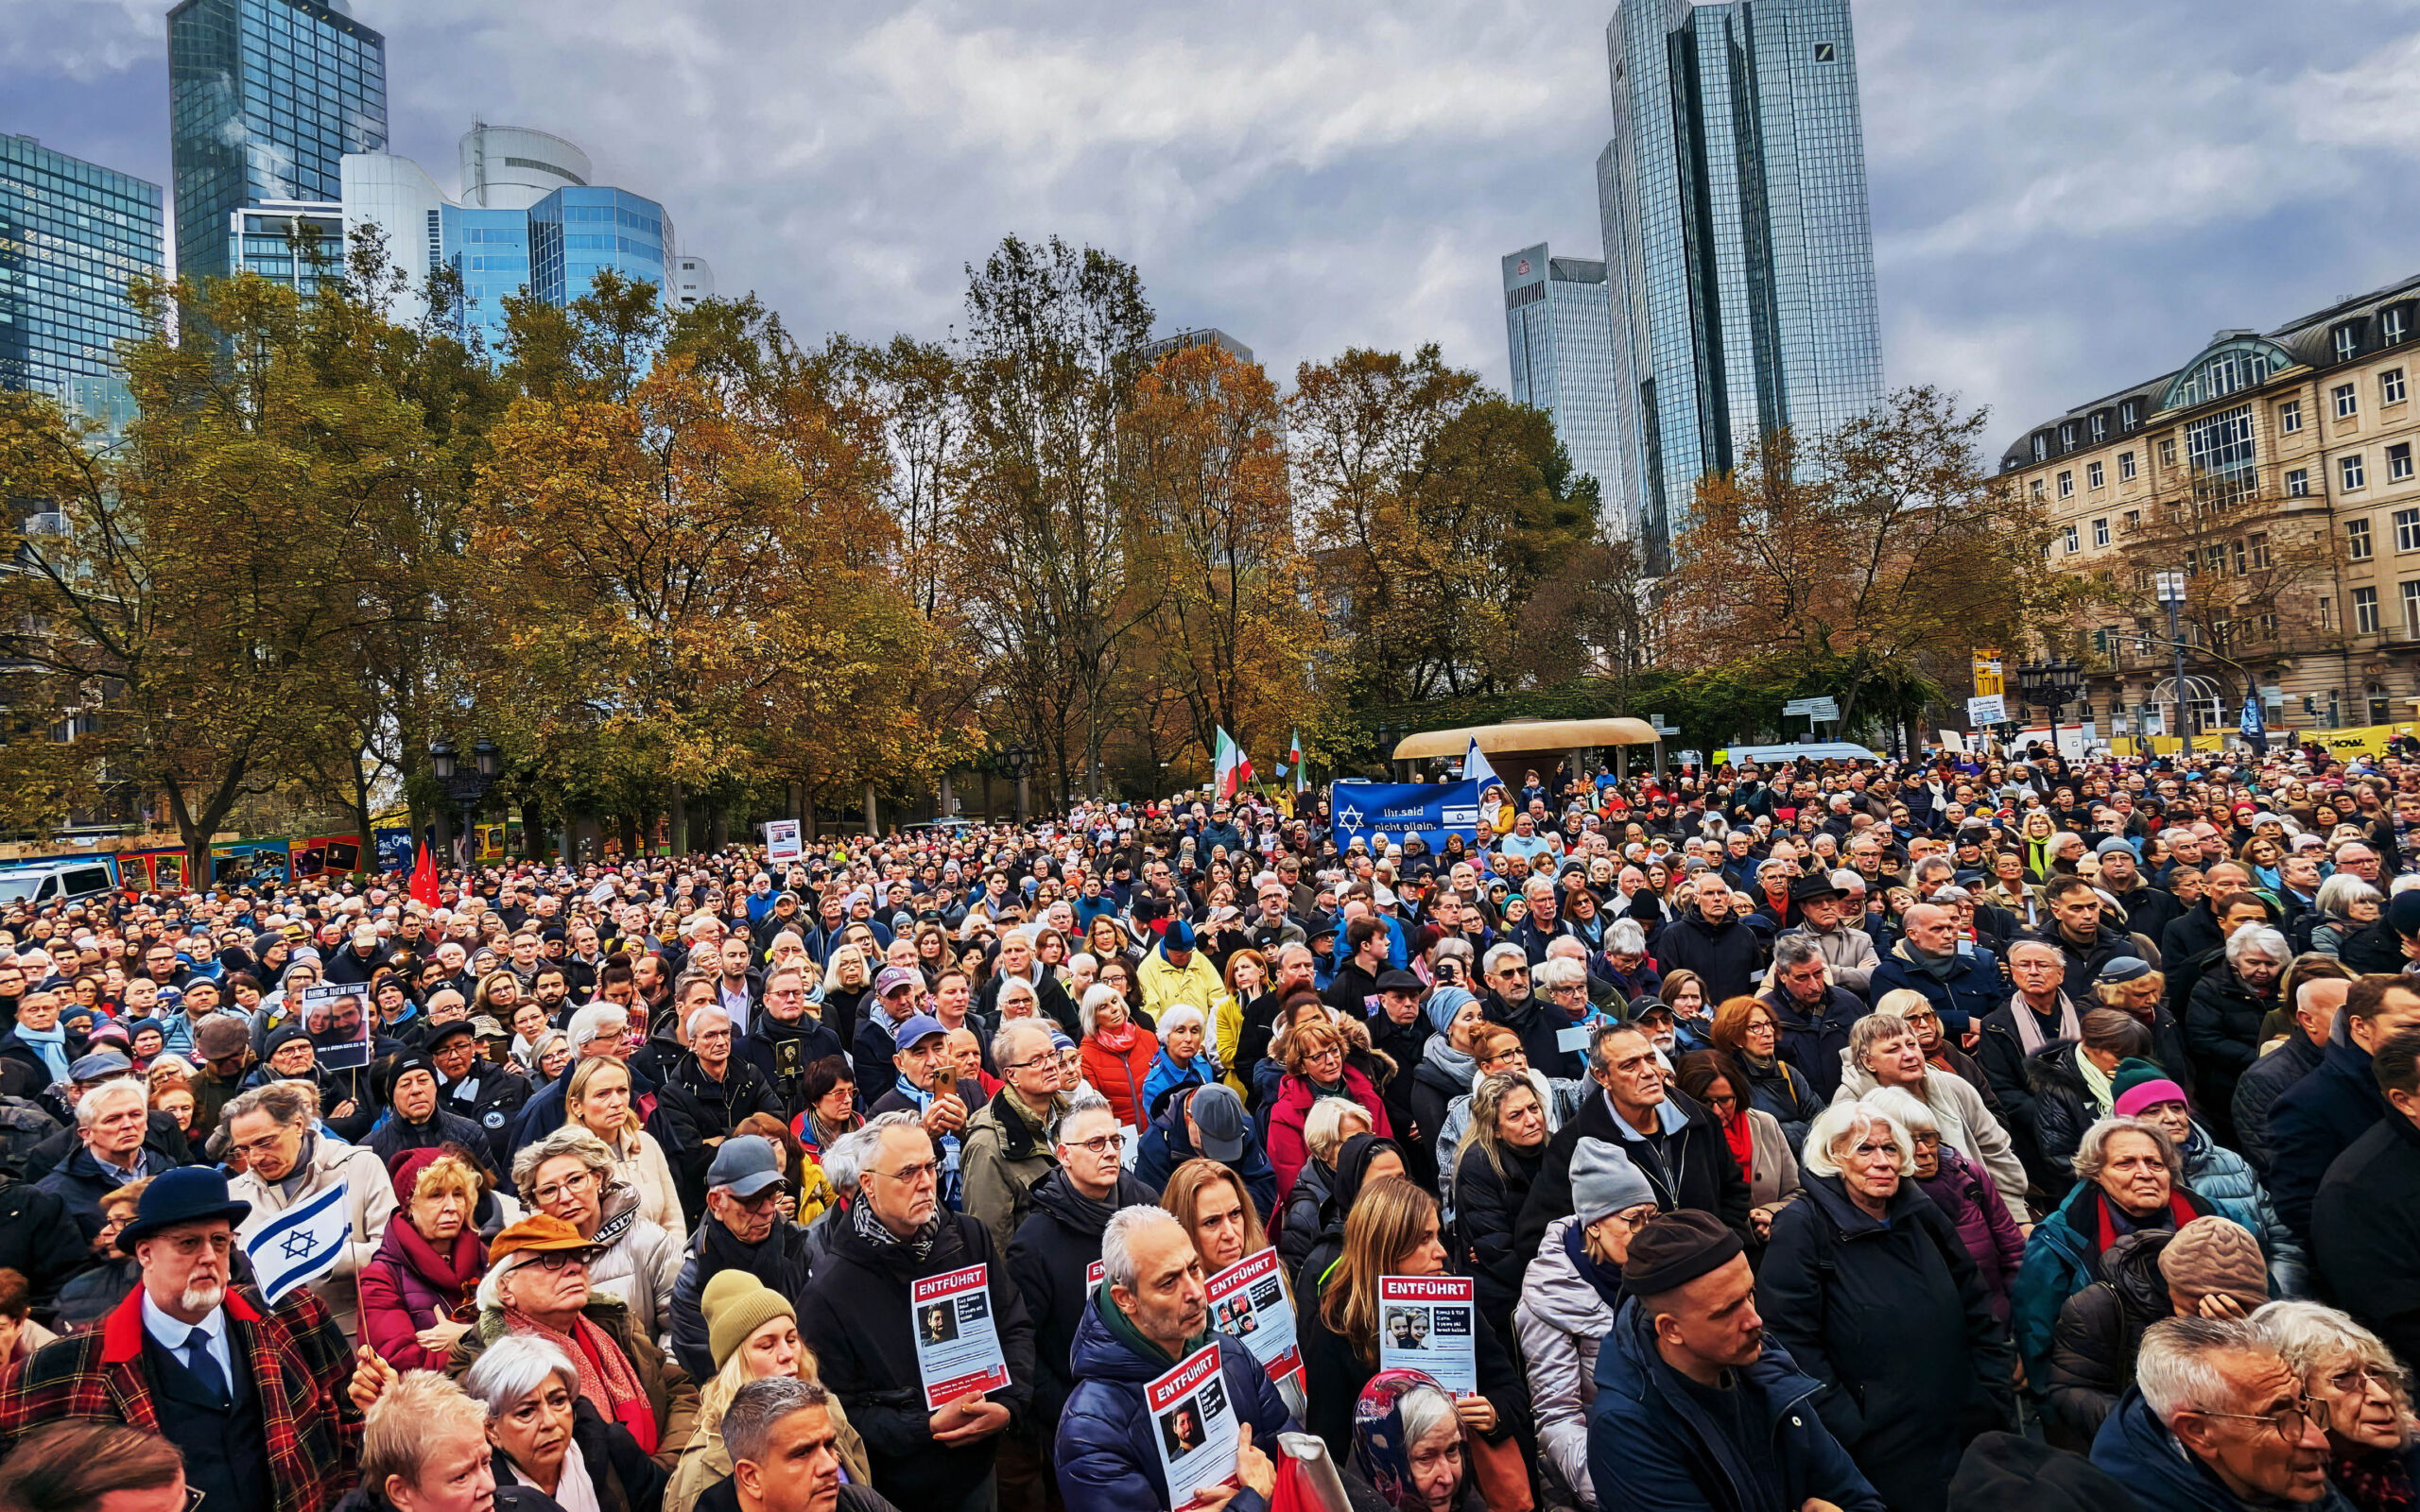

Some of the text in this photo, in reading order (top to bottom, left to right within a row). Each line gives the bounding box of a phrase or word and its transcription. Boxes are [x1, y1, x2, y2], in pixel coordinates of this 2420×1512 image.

[1384, 808, 1398, 816] Ihr
[1374, 821, 1437, 832] nicht allein.
[919, 1270, 982, 1296] ENTFÜHRT
[1210, 1257, 1270, 1296] ENTFÜHRT
[1388, 1280, 1467, 1296] ENTFÜHRT
[1156, 1353, 1214, 1402] ENTFÜHRT
